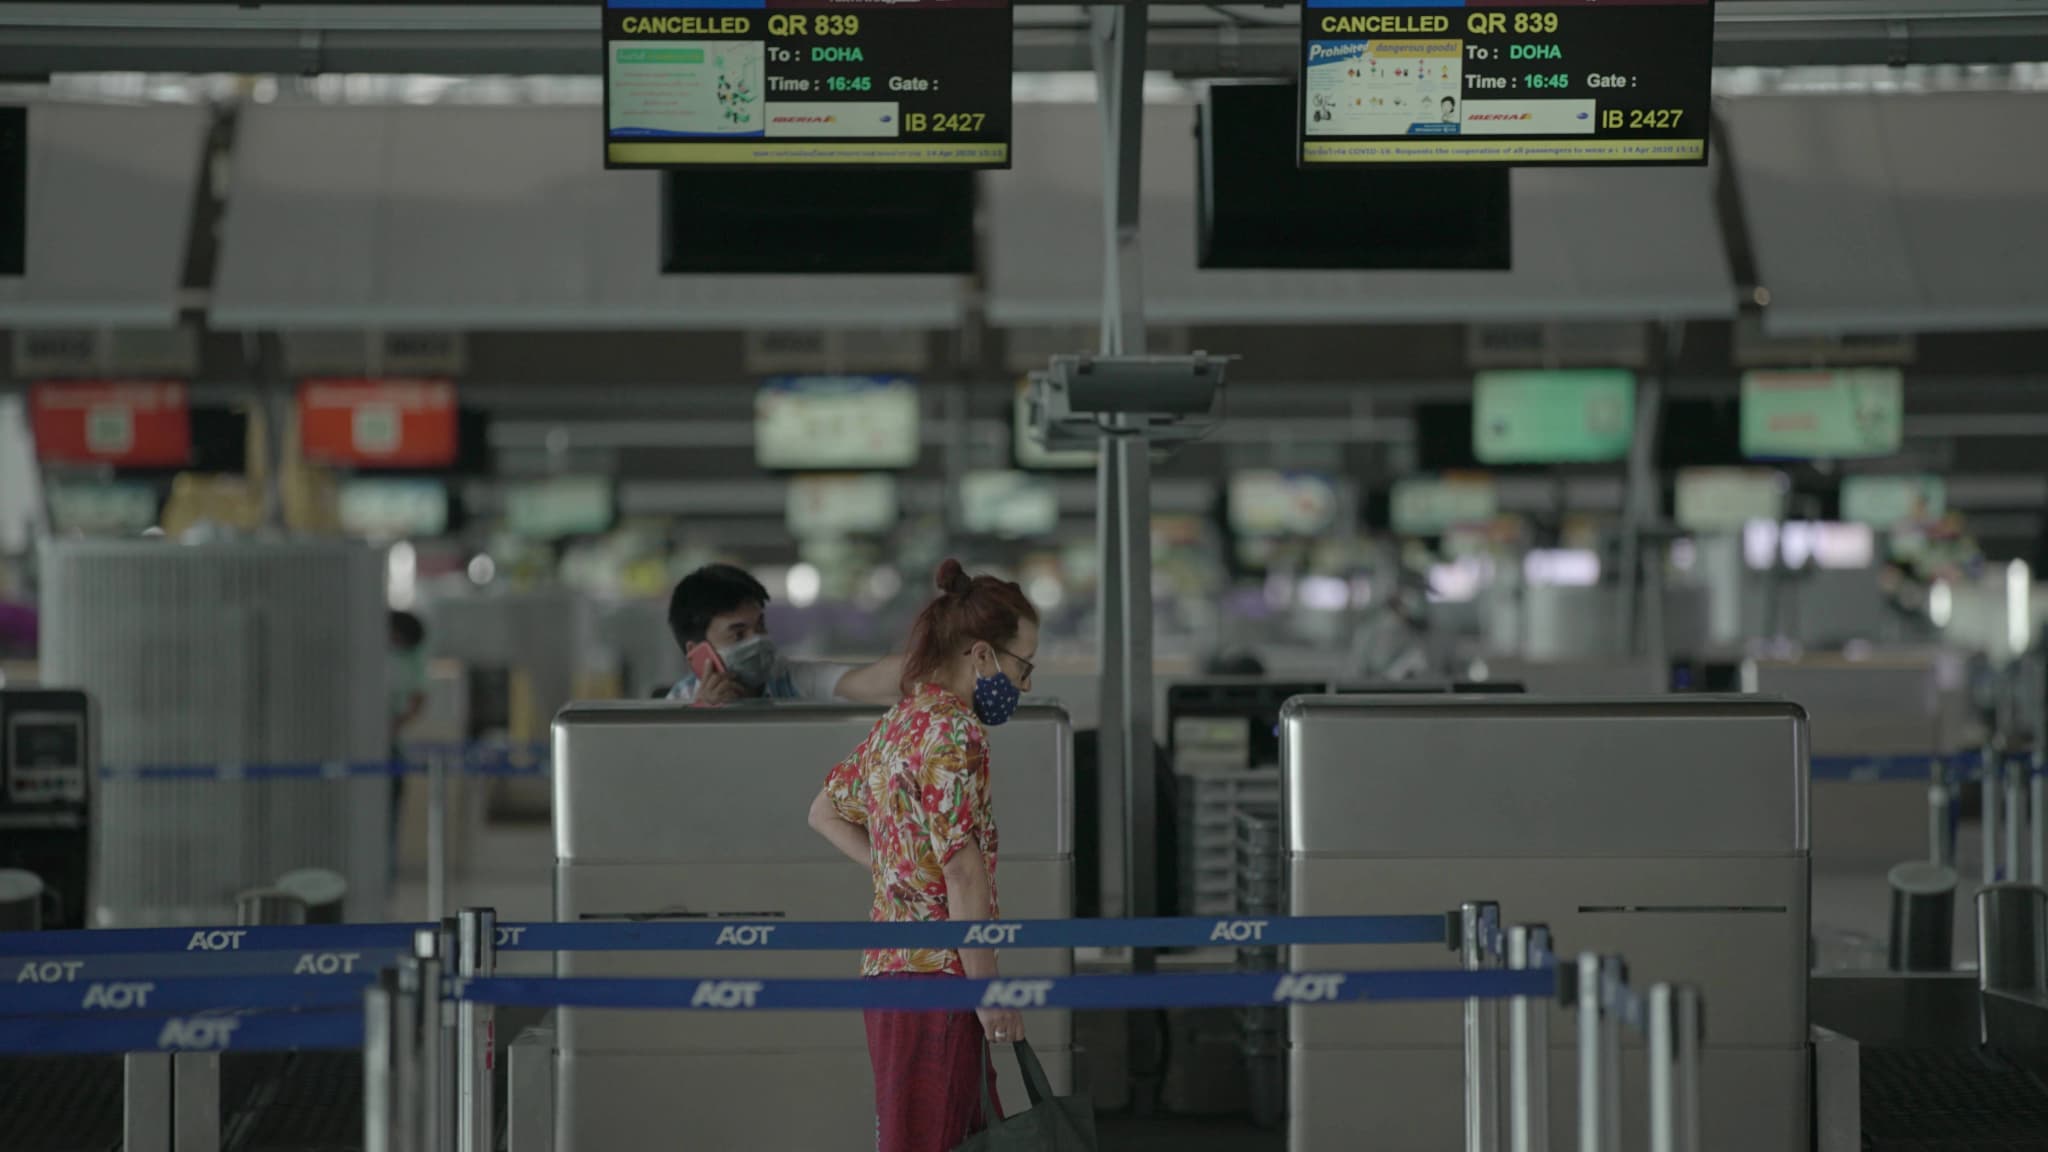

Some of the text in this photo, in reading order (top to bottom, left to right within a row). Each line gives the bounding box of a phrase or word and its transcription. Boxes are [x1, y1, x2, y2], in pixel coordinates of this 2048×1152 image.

[622, 16, 751, 34] CANCELLED
[767, 14, 859, 36] QR 839
[1321, 15, 1449, 33] CANCELLED
[1466, 12, 1559, 35] QR 839
[811, 46, 864, 62] DOHA
[1509, 44, 1563, 60] DOHA
[826, 76, 872, 91] 16:45
[1523, 73, 1569, 89] 16:45
[905, 112, 986, 132] IB 2427
[1602, 109, 1684, 129] IB 2427
[1635, 146, 1649, 155] Apr
[716, 926, 775, 945] AOT
[963, 923, 1022, 944] AOT
[1210, 920, 1268, 941] AOT
[187, 931, 247, 951] AOT
[17, 961, 84, 983] AOT
[294, 952, 361, 974] AOT
[82, 982, 155, 1009] AOT
[691, 981, 763, 1008] AOT
[981, 980, 1054, 1006] AOT
[1273, 974, 1346, 1001] AOT
[157, 1017, 239, 1049] AOT
